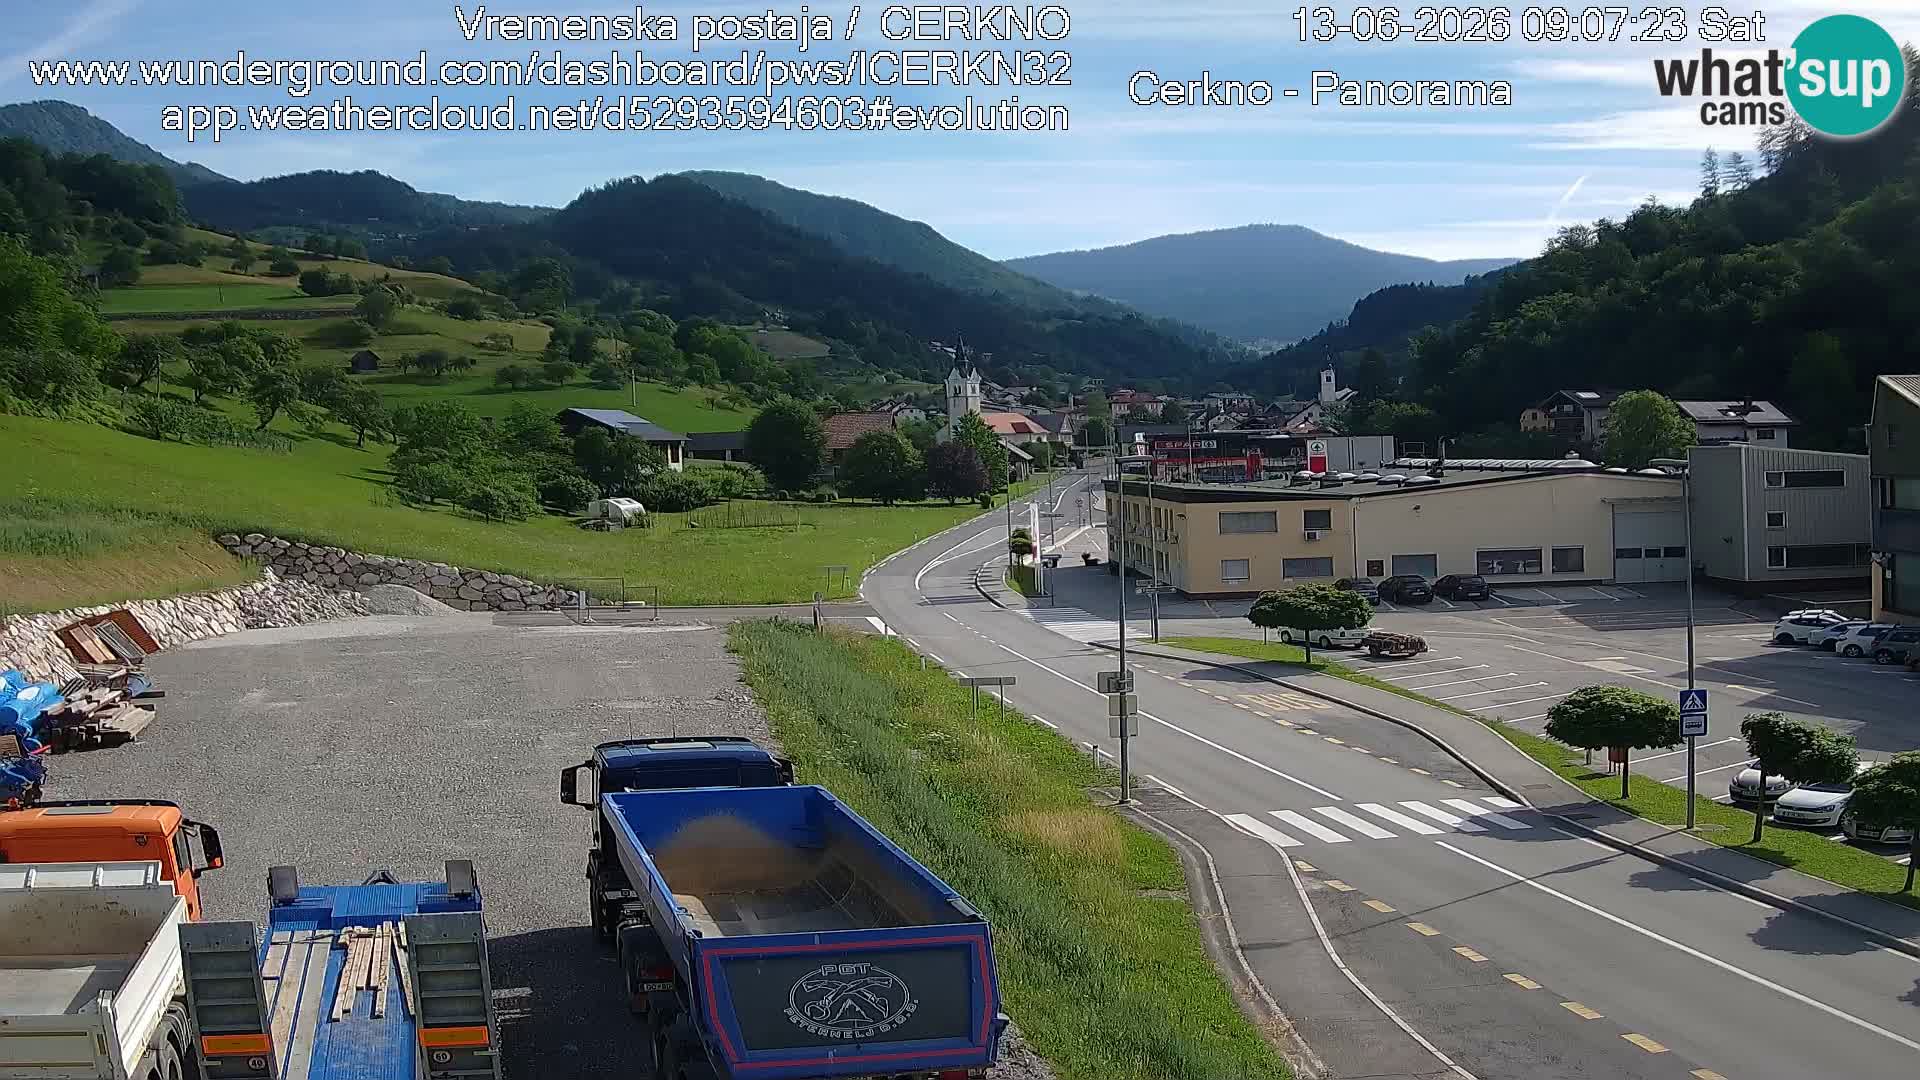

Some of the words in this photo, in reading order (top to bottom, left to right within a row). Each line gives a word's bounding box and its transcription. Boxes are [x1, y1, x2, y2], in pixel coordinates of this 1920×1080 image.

[1166, 441, 1201, 449] SPAR
[1234, 693, 1332, 711] BUS
[783, 1007, 876, 1039] PETERNELJ
